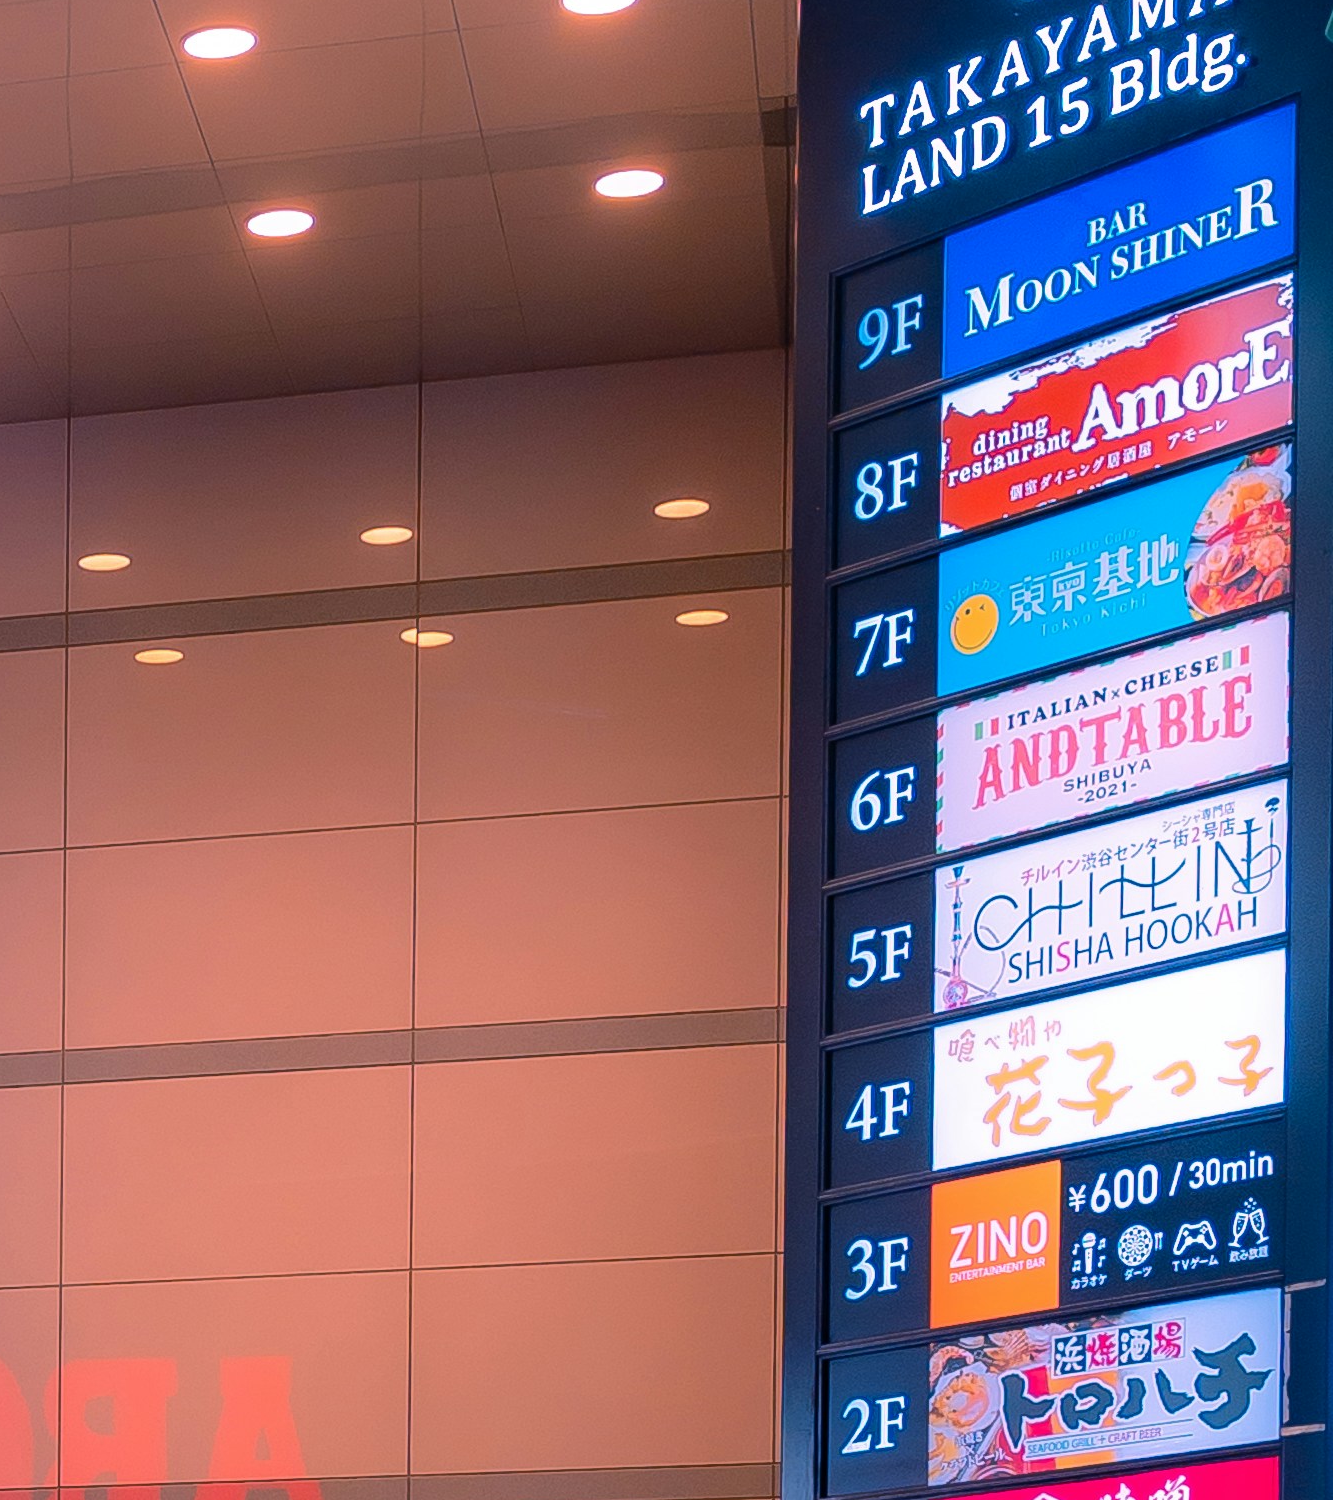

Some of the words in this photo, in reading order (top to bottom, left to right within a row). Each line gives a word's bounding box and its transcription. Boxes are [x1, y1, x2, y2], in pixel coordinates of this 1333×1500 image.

[860, 111, 1008, 217] LAND
[1024, 76, 1091, 151] 15
[1108, 30, 1250, 133] Bldg.
[1085, 202, 1148, 248] BAR
[857, 293, 924, 370] 9F
[946, 428, 1073, 488] restaurant
[1071, 324, 1291, 453] AmorE
[972, 414, 1050, 457] dining
[1166, 417, 1229, 450] アモーレ
[854, 452, 920, 521] 8F
[853, 608, 915, 677] 7F
[1039, 610, 1093, 639] Tokyo
[971, 673, 1255, 812] ANDTABLE
[850, 765, 916, 833] 6F
[1062, 757, 1154, 795] SHIBUYA
[1161, 800, 1237, 834] シーシャ専門店
[847, 923, 913, 990] 5F
[1007, 930, 1115, 986] SHISHA
[1123, 896, 1259, 959] HOOKAH
[844, 1080, 912, 1142] 4F
[982, 1033, 1275, 1148] 花子っ子
[1068, 1162, 1160, 1214] ¥600
[1188, 1150, 1275, 1190] 30min
[844, 1236, 911, 1302] 3F
[949, 1209, 1049, 1270] ZINO
[949, 1260, 1024, 1285] ENTERTAINMENT
[1025, 1255, 1047, 1271] BAR
[1070, 1272, 1108, 1292] カラオケ
[1123, 1265, 1153, 1283] ダーツ
[1171, 1254, 1221, 1275] TVゲーム
[998, 1331, 1275, 1452] トロハチ
[841, 1396, 907, 1456] 2F
